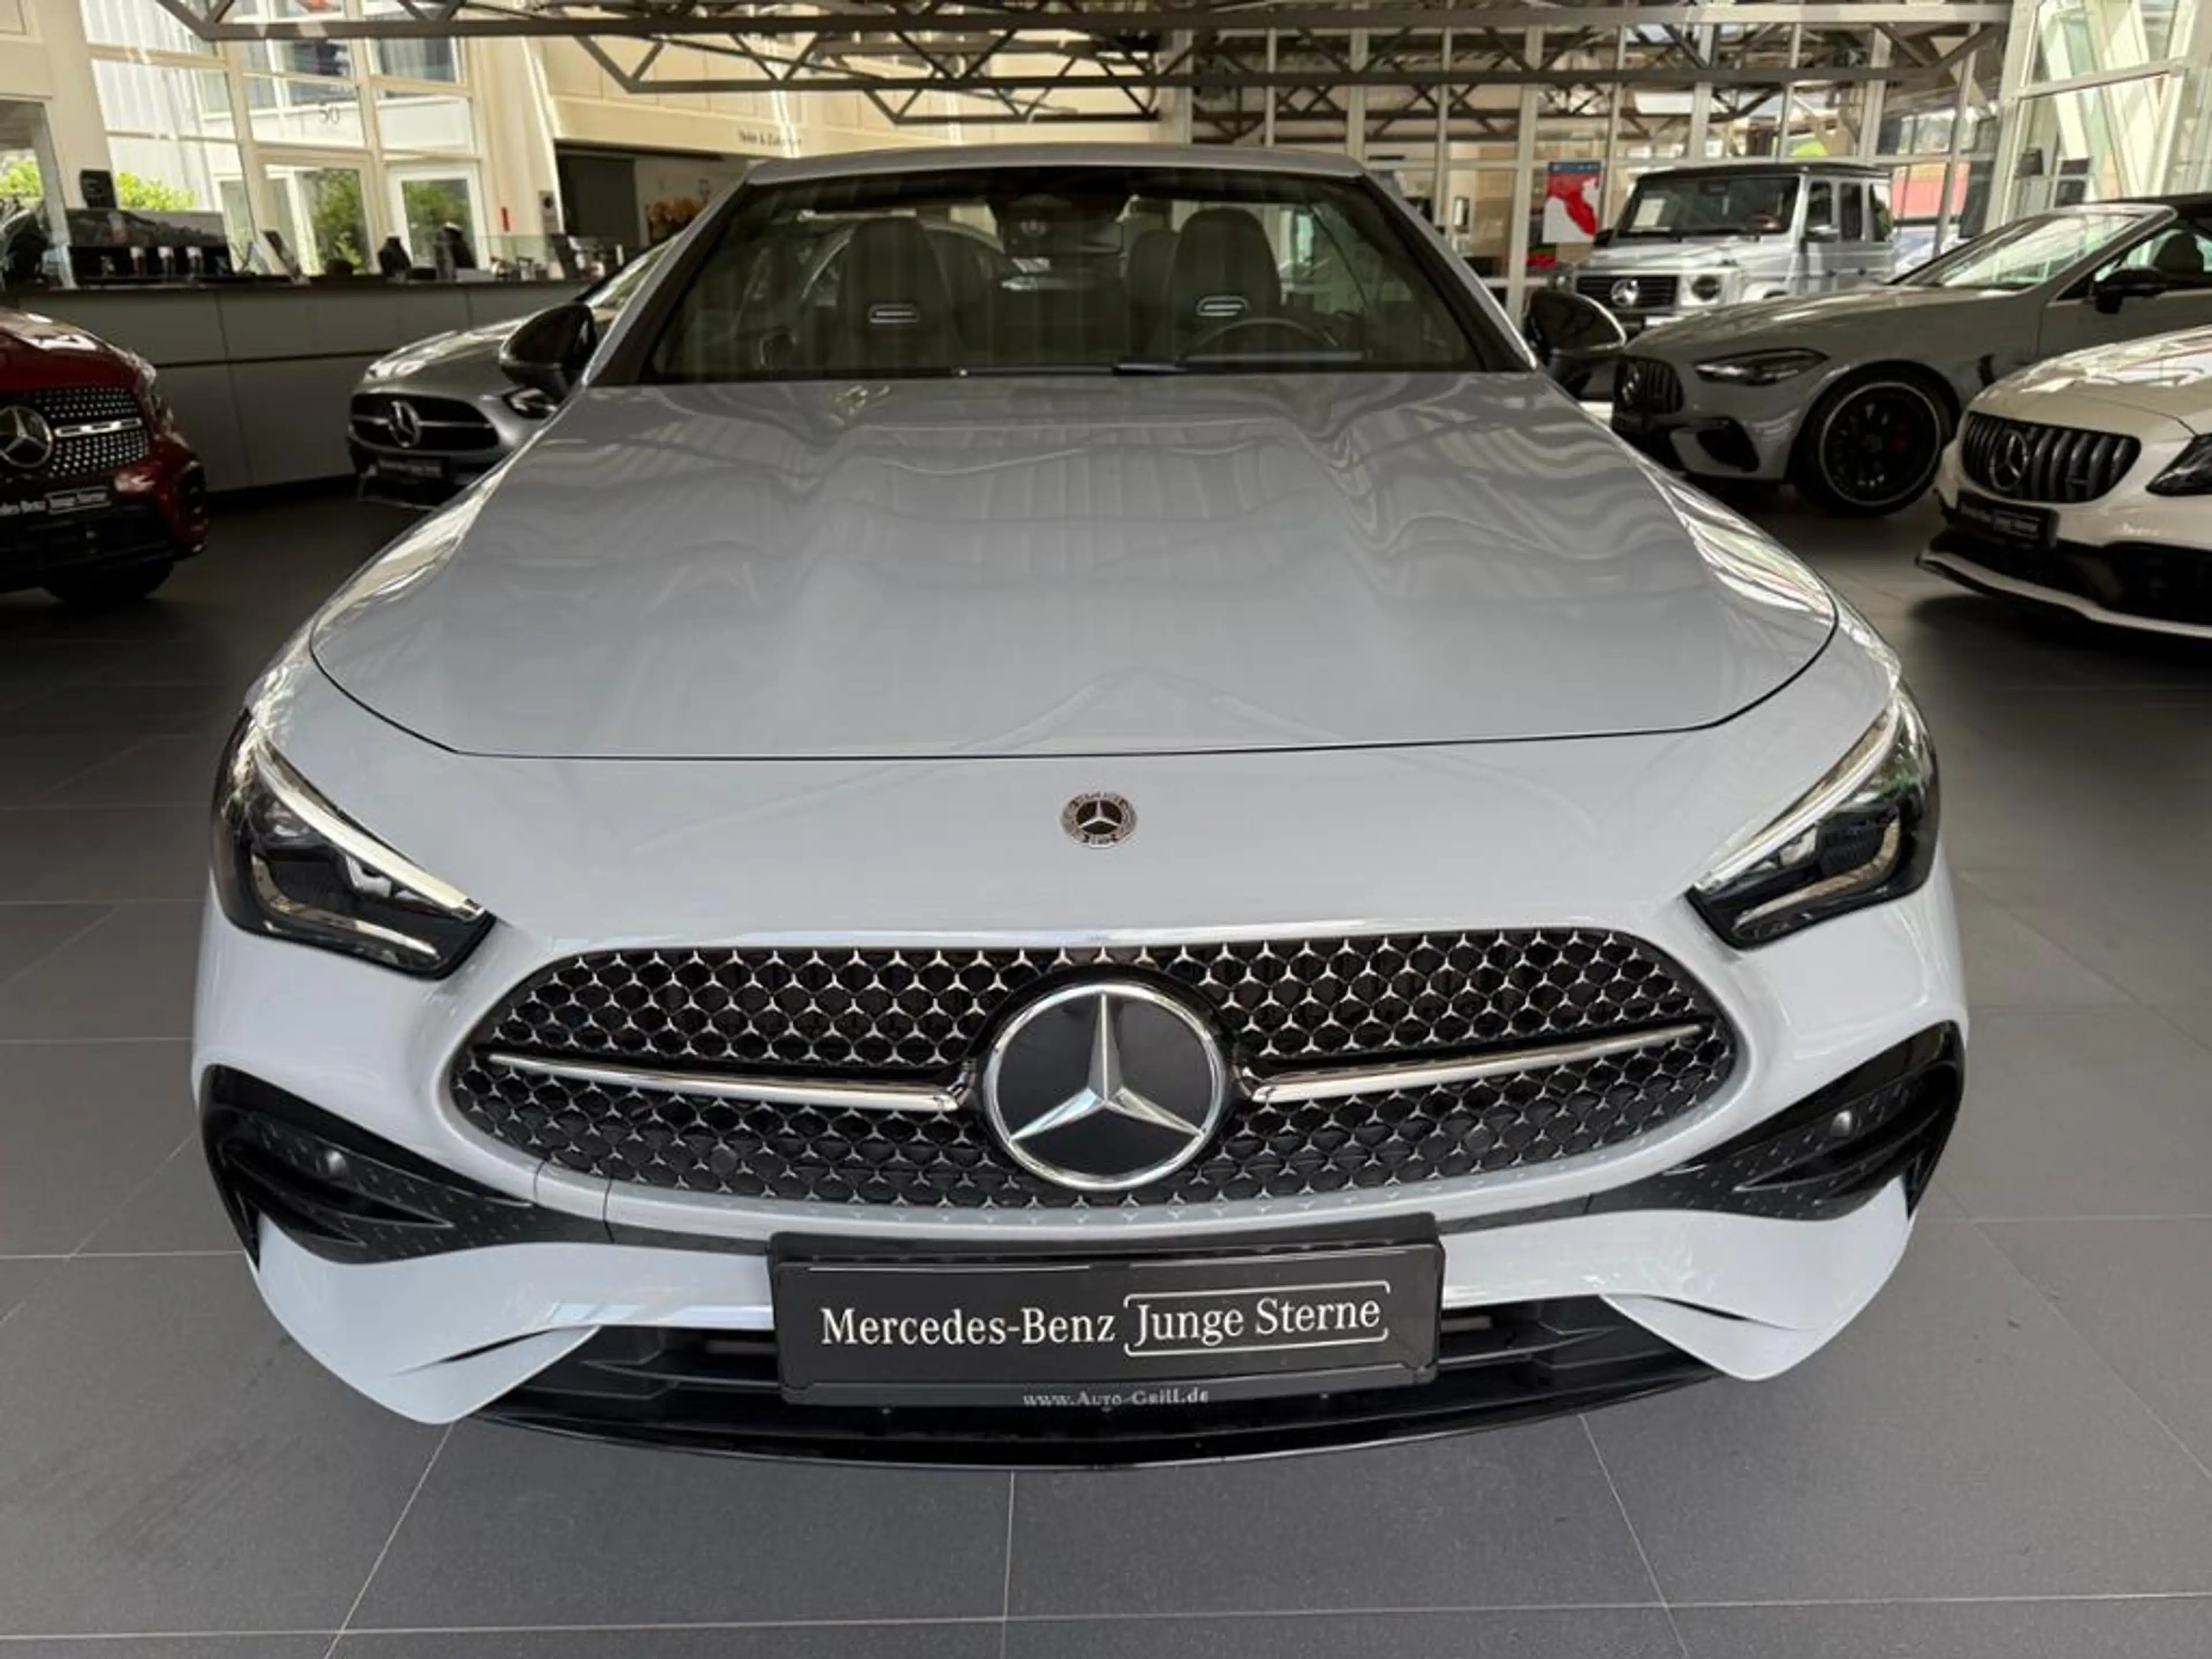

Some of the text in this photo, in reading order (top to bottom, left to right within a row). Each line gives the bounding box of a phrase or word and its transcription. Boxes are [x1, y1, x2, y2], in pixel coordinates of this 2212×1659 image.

[820, 1297, 1380, 1347] Mercedes-Benz Junge Sterne
